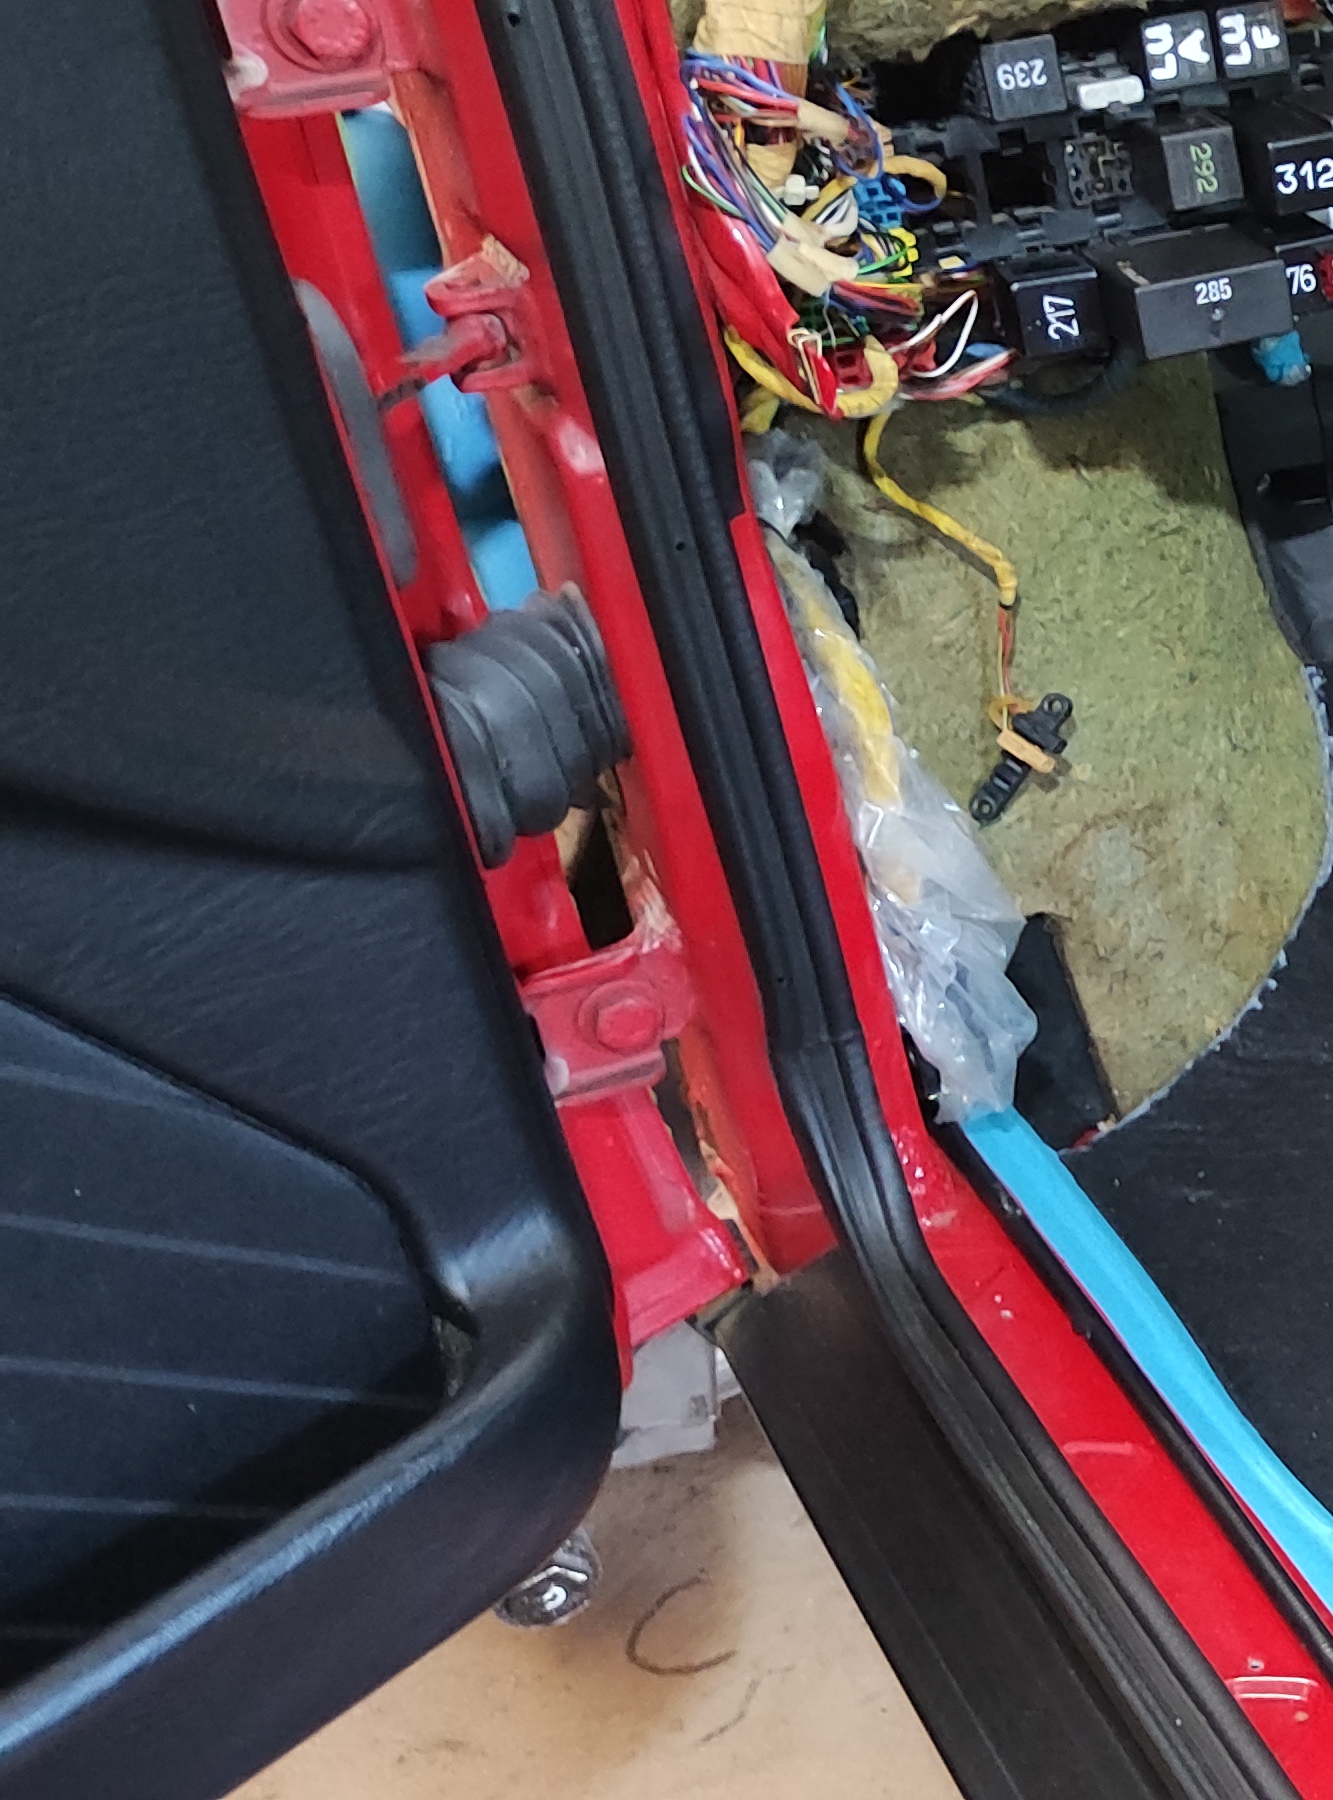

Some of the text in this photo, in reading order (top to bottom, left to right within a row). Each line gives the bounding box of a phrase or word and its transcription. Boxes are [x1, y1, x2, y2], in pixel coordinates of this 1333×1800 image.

[1144, 22, 1178, 80] LU
[1177, 28, 1211, 64] A
[1219, 13, 1252, 66] LU
[1251, 24, 1281, 50] F
[995, 58, 1048, 91] 239
[1189, 142, 1219, 194] 292
[1194, 277, 1232, 305] 285
[1043, 294, 1080, 340] 217
